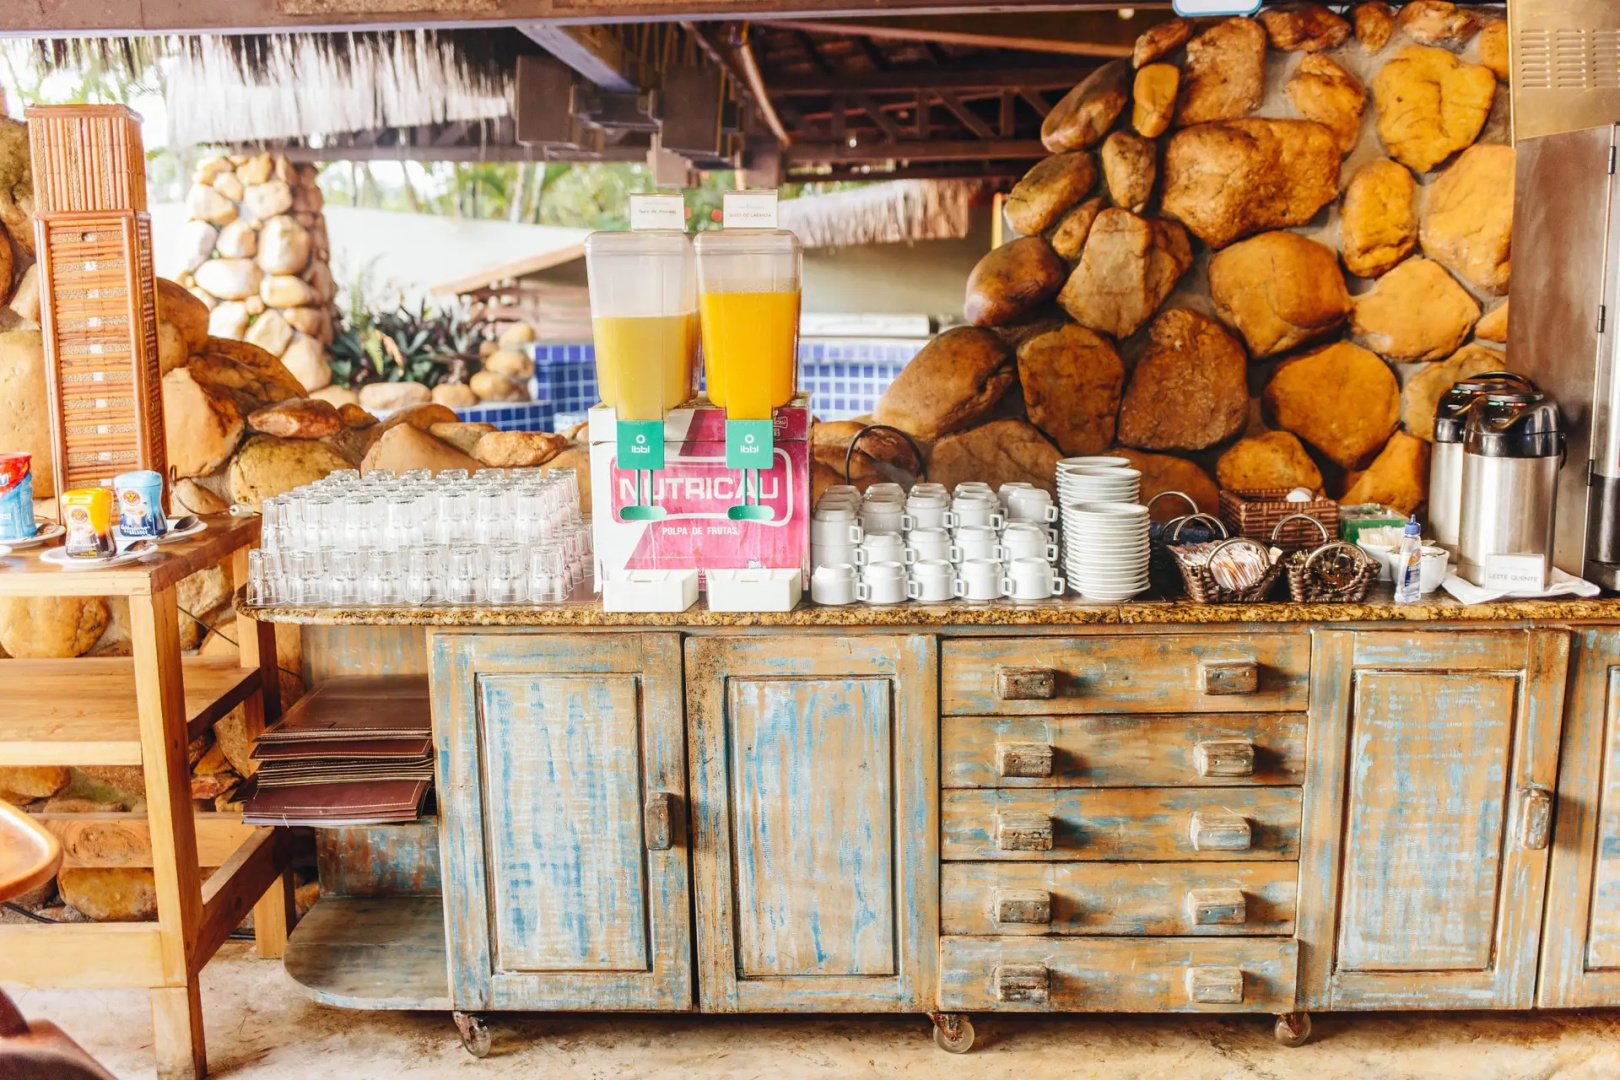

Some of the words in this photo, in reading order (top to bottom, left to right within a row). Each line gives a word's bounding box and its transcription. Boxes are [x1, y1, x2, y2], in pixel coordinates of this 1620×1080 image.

[662, 527, 688, 535] POLPA
[692, 527, 702, 535] DE
[1488, 572, 1508, 580] LEITE
[1510, 575, 1539, 583] QUENTE
